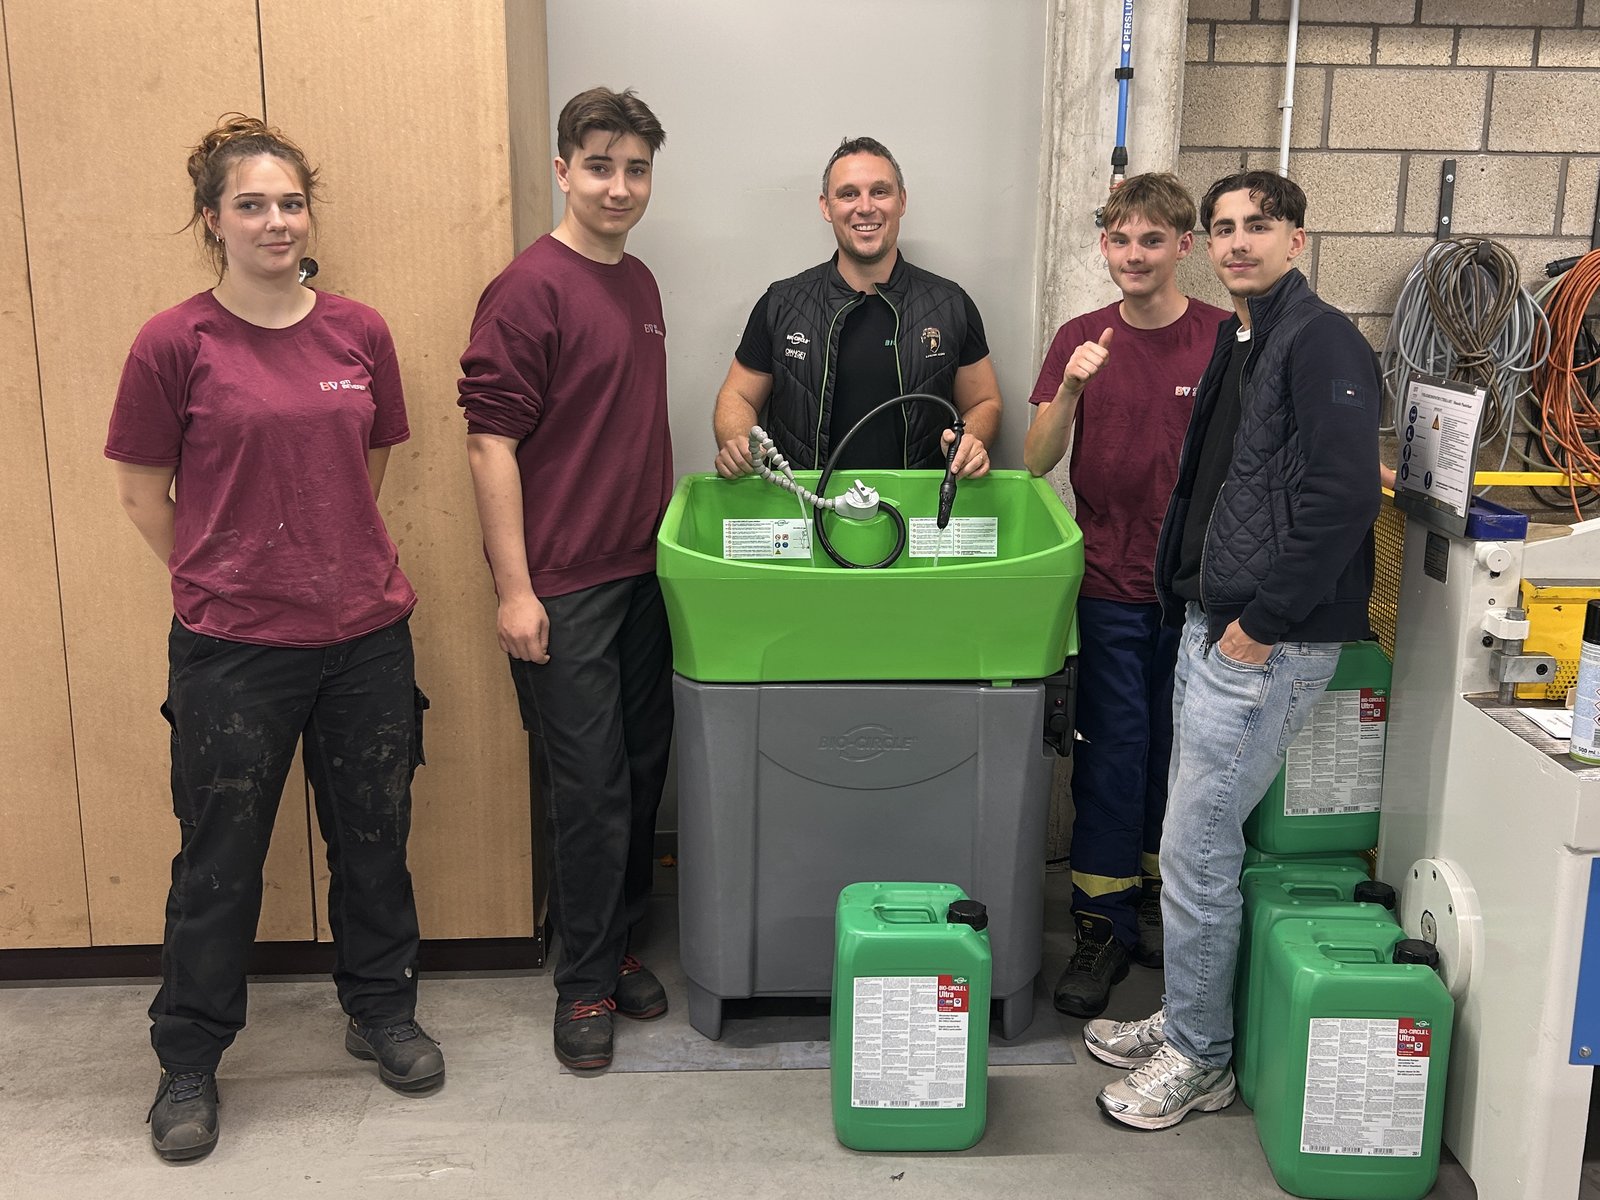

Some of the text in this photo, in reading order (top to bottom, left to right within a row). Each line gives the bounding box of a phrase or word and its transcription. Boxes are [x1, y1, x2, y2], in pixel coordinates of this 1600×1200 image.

[320, 381, 338, 391] BV
[1174, 385, 1191, 397] BV
[1578, 746, 1588, 754] 500
[1399, 1034, 1416, 1042] Ultra
